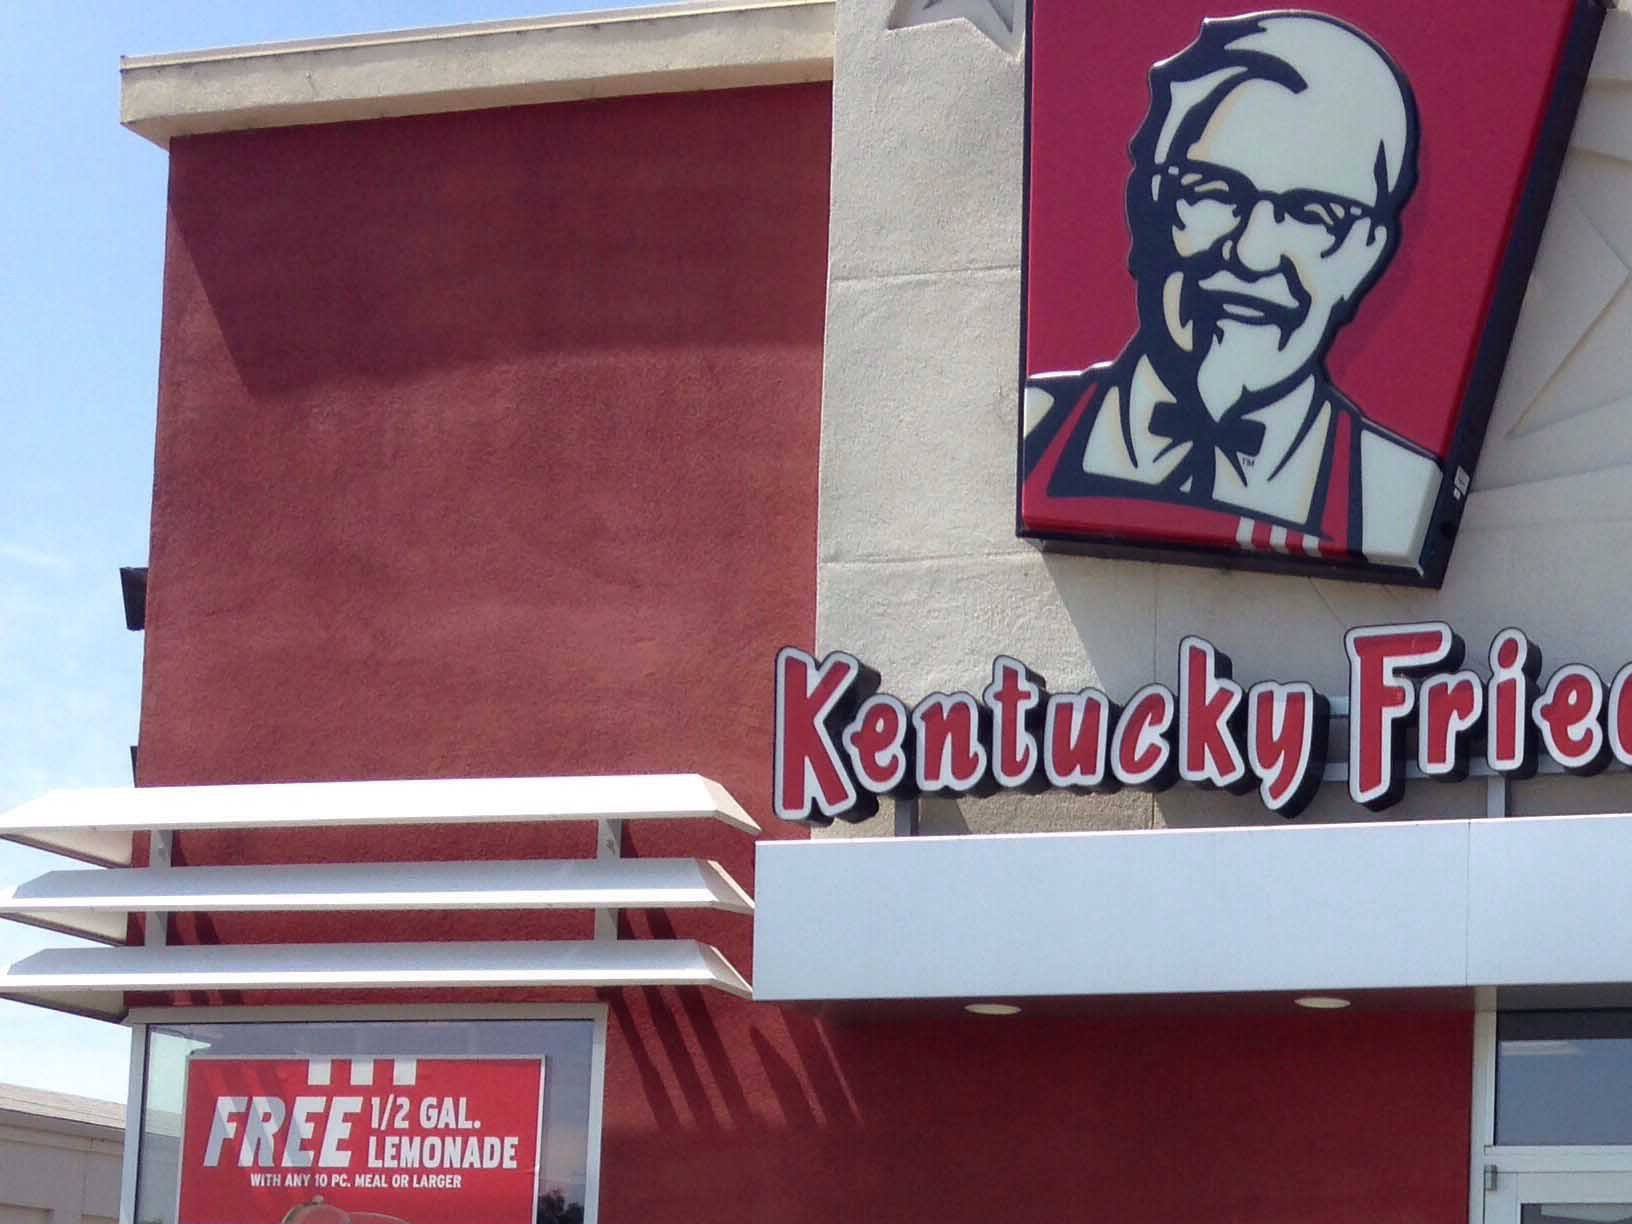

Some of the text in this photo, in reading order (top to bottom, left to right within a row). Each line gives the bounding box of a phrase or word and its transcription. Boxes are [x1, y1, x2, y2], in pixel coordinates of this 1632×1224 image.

[775, 636, 1320, 820] Kentucky
[371, 1094, 482, 1131] 1/2 GAL.
[203, 1096, 364, 1168] FREE
[367, 1136, 519, 1169] LEMONADE
[250, 1173, 462, 1189] WITH ANY 10 PC. MEAL OR LARGER
